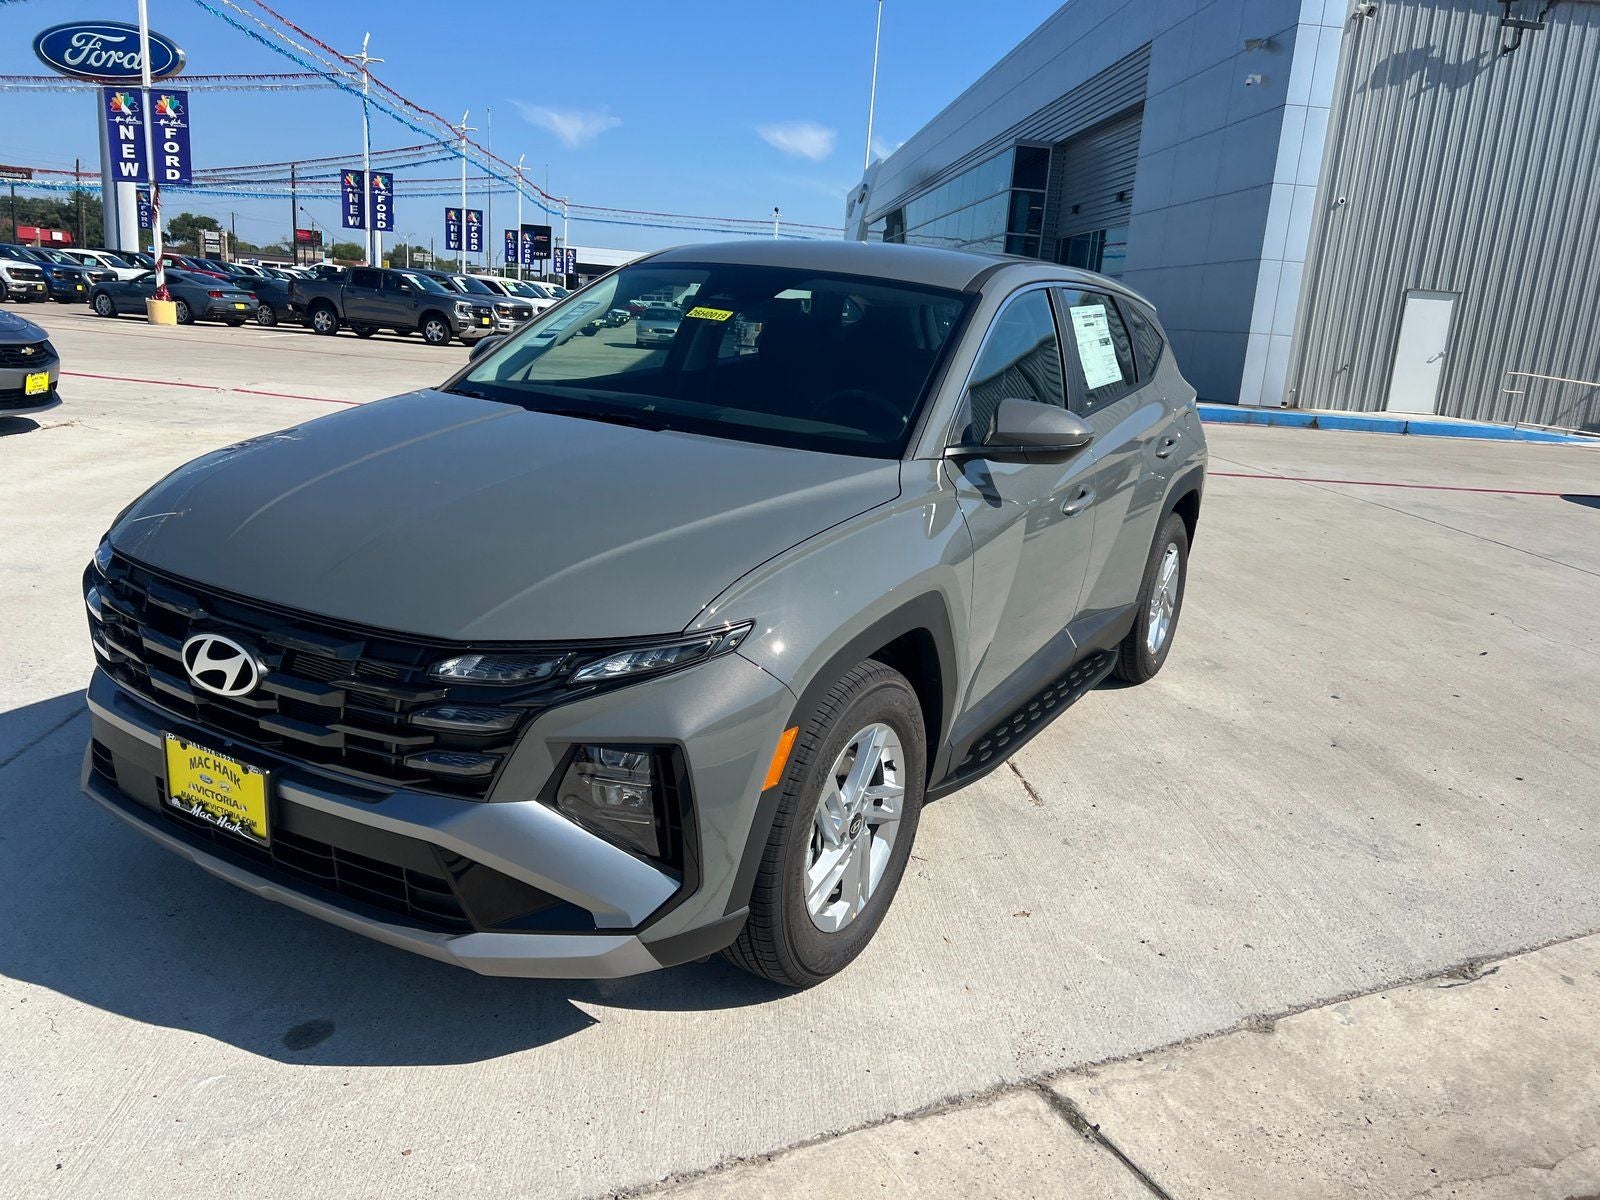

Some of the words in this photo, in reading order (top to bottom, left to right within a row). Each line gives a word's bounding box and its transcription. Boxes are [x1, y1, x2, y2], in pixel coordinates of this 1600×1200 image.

[64, 32, 153, 70] Ford
[119, 125, 139, 177] NEW
[163, 128, 180, 180] FORD
[347, 193, 360, 226] NEW
[376, 195, 387, 229] FORD
[449, 224, 459, 249] NEW
[470, 226, 478, 250] FORD
[507, 242, 515, 262] NEW
[189, 757, 211, 770] MAC
[213, 760, 241, 790] HAIK
[195, 783, 240, 810] VICTORIA
[190, 803, 214, 822] Mac
[216, 815, 243, 832] Haik
